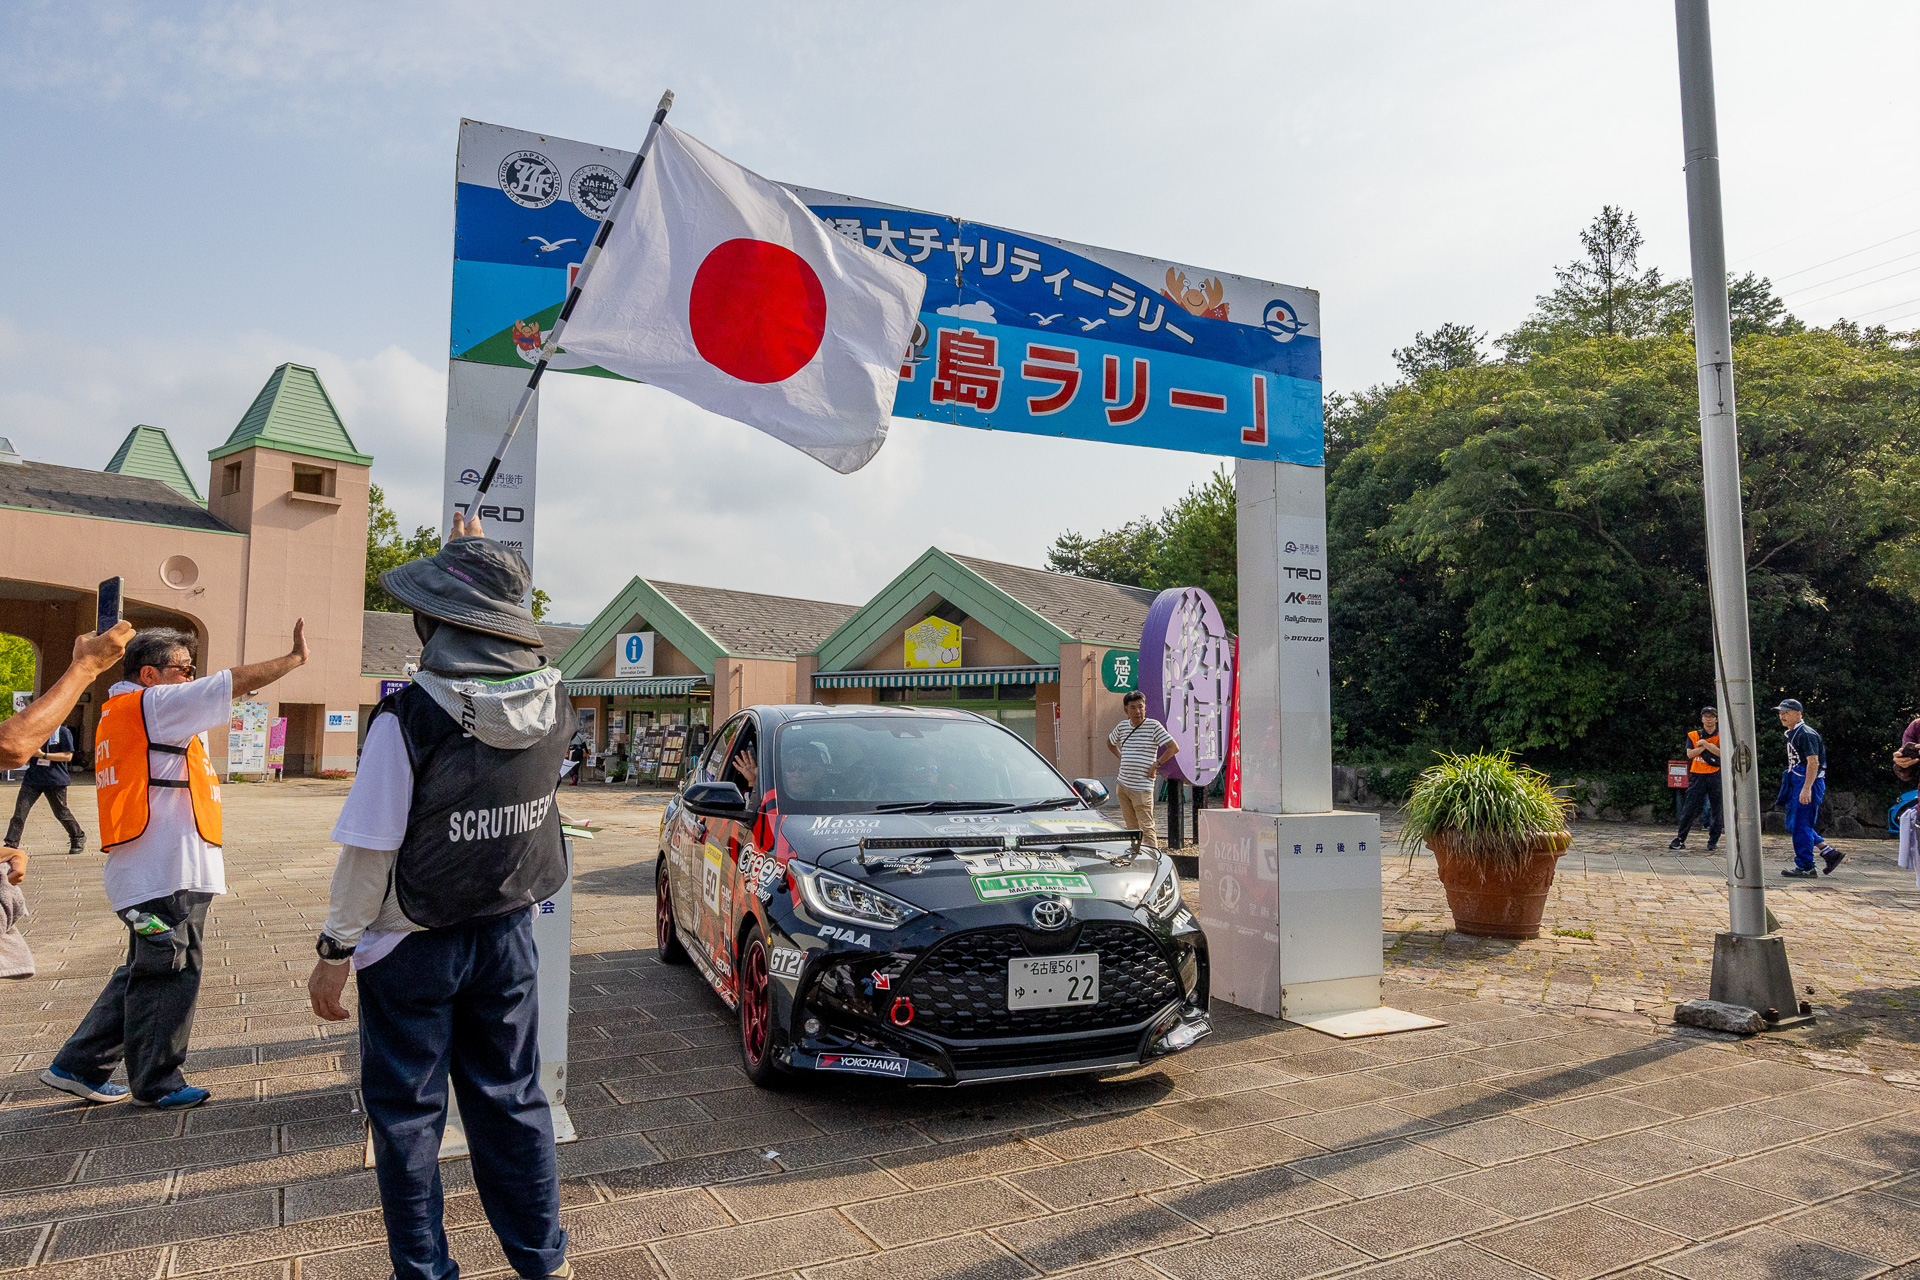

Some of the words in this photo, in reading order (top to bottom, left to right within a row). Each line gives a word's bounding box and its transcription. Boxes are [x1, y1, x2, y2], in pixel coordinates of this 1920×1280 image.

[517, 152, 548, 164] JAPAN
[500, 161, 525, 205] FEDERATION
[533, 171, 560, 207] AUTOMOBILE
[899, 328, 1267, 446] 島ラリー」
[455, 503, 524, 523] TRD
[1283, 566, 1321, 581] TRD
[807, 816, 881, 831] Massa
[949, 815, 999, 823] GT2i
[1293, 841, 1367, 854] 京丹後市
[739, 842, 787, 888] Creer
[706, 868, 717, 901] 50
[756, 885, 771, 903] shop
[817, 925, 871, 948] PIAA
[770, 946, 808, 975] GT2i
[1067, 975, 1094, 1001] 22
[840, 1056, 901, 1072] YOKOHAMA
